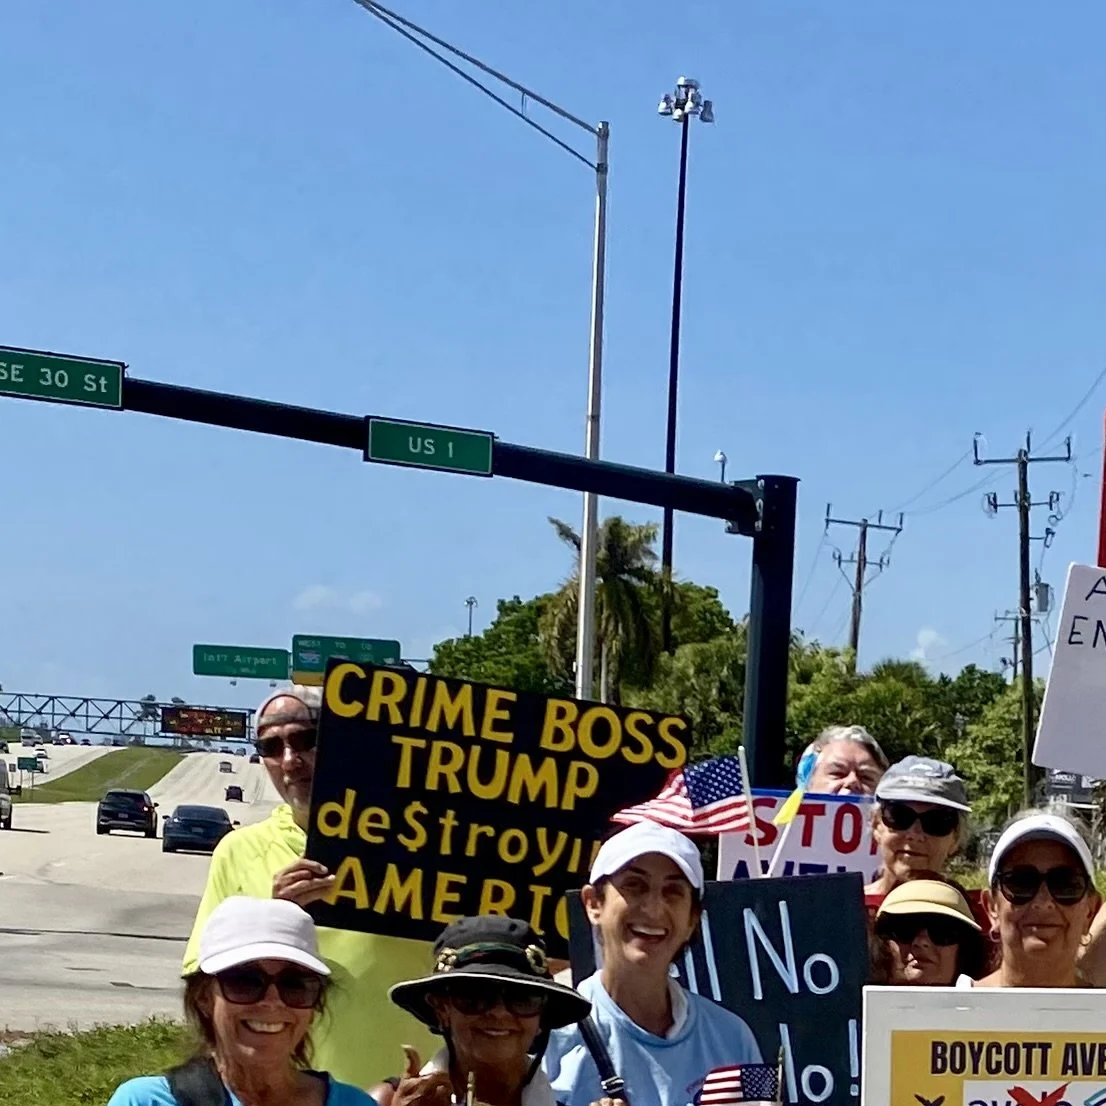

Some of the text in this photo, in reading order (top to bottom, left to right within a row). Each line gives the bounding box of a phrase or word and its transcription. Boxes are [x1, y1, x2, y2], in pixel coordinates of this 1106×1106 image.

[0, 362, 107, 393] SE 30 St
[408, 436, 454, 458] US 1
[324, 663, 688, 769] CRIME BOSS
[391, 735, 600, 811] TRUMP
[744, 797, 880, 856] STO
[325, 856, 569, 941] AMERI
[742, 900, 840, 1000] No
[930, 1040, 1053, 1076] BOYCOTT
